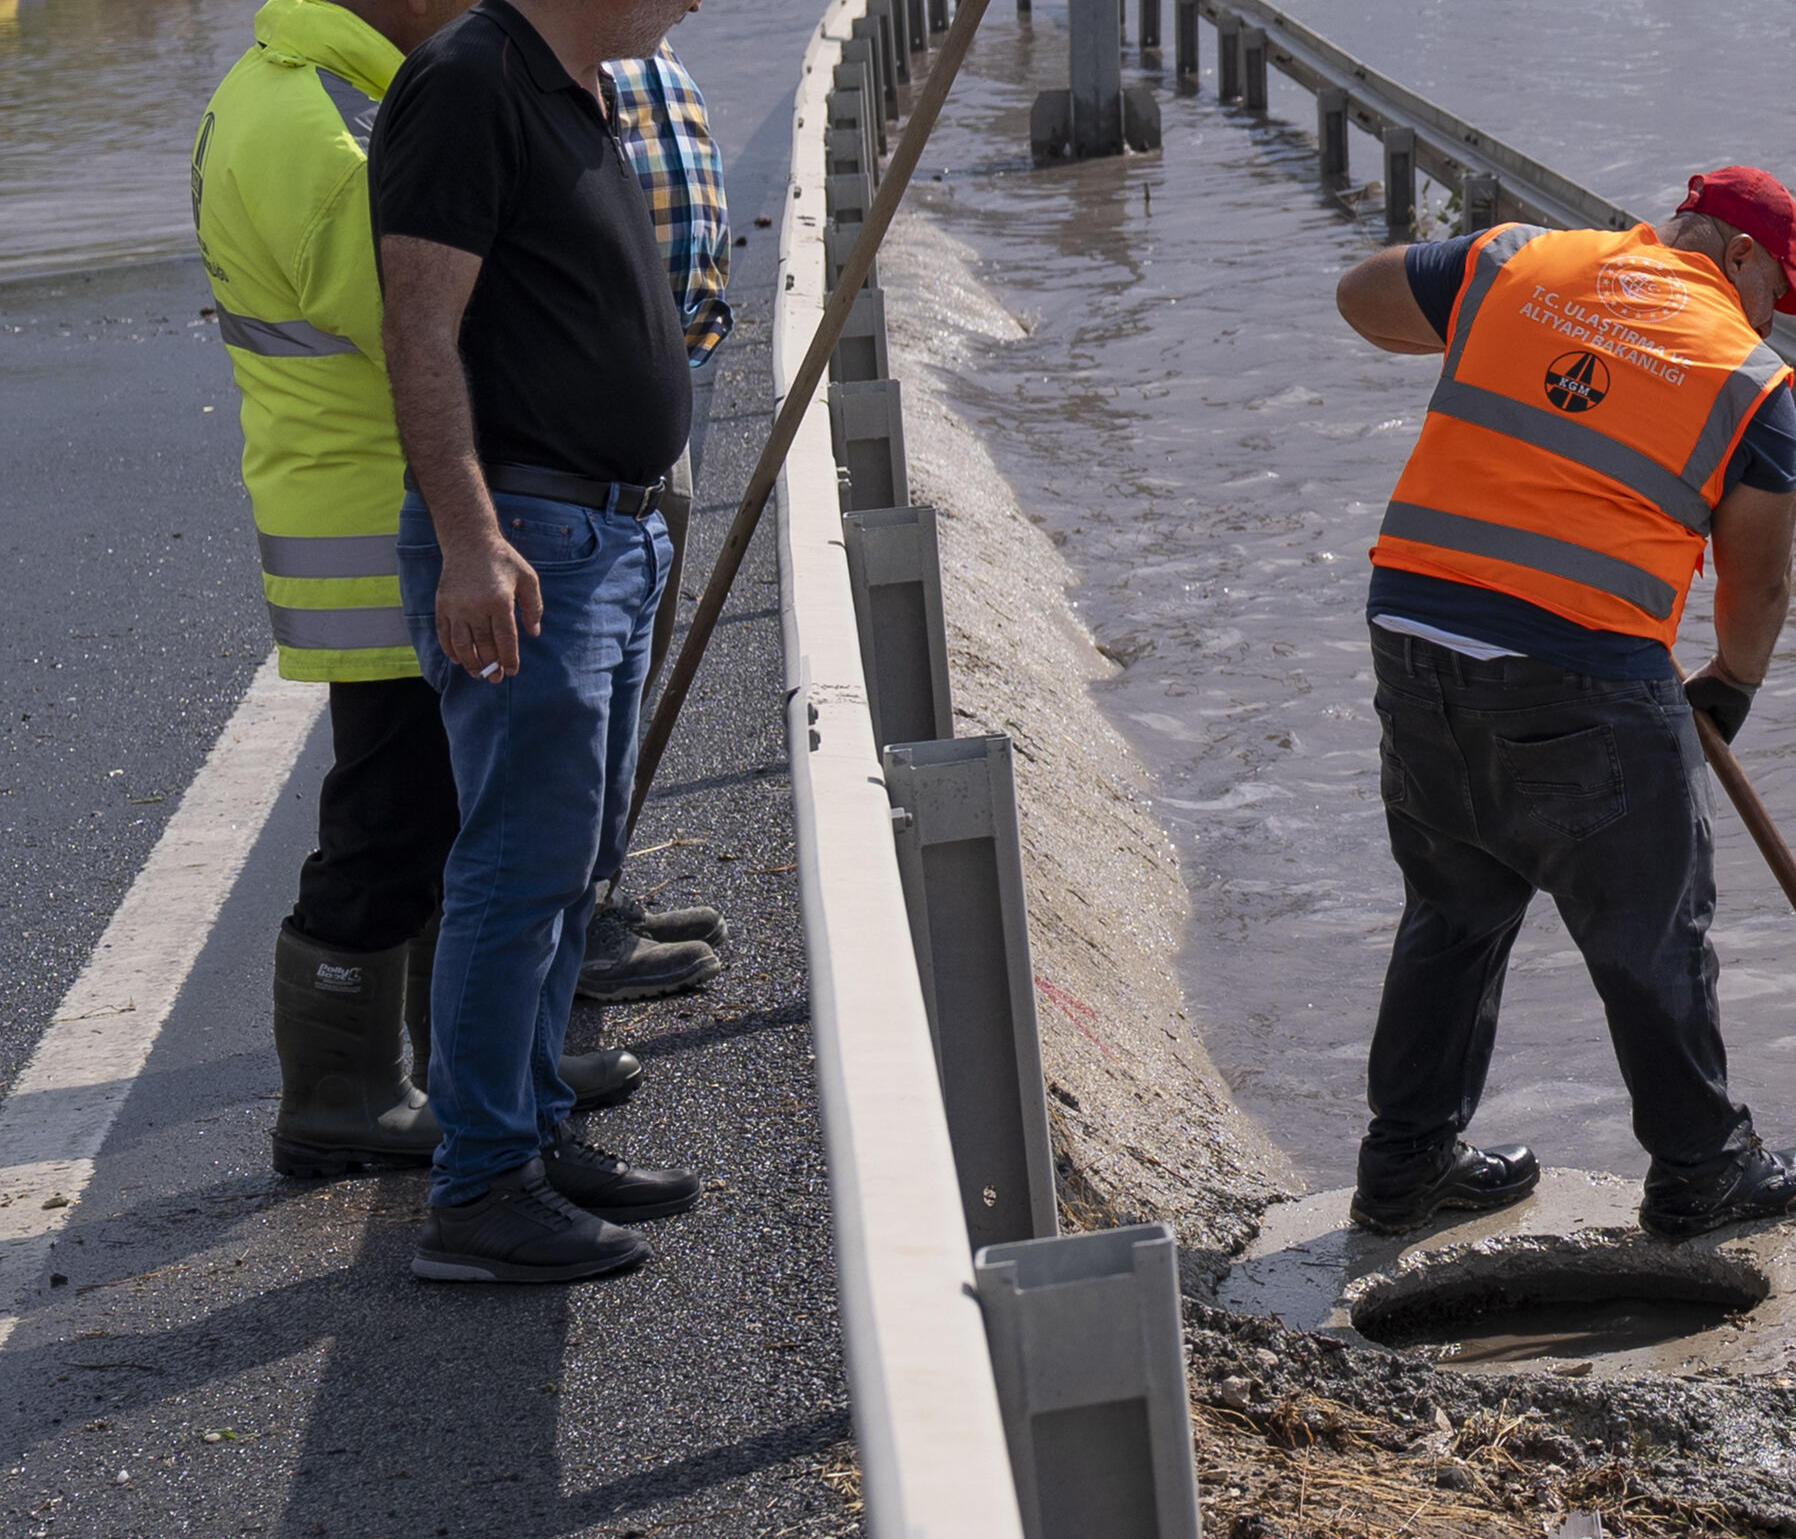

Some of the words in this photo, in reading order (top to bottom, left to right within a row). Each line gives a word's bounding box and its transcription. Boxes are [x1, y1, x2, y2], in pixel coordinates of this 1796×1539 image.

[1519, 302, 1591, 342] ALTYAPI
[1591, 335, 1688, 387] BAKANLIĞI
[1531, 285, 1559, 309] T.C.
[1564, 301, 1666, 357] ULAŞTIRMA
[1670, 350, 1692, 370] VE
[1558, 377, 1591, 397] KGM
[318, 963, 350, 980] Polly
